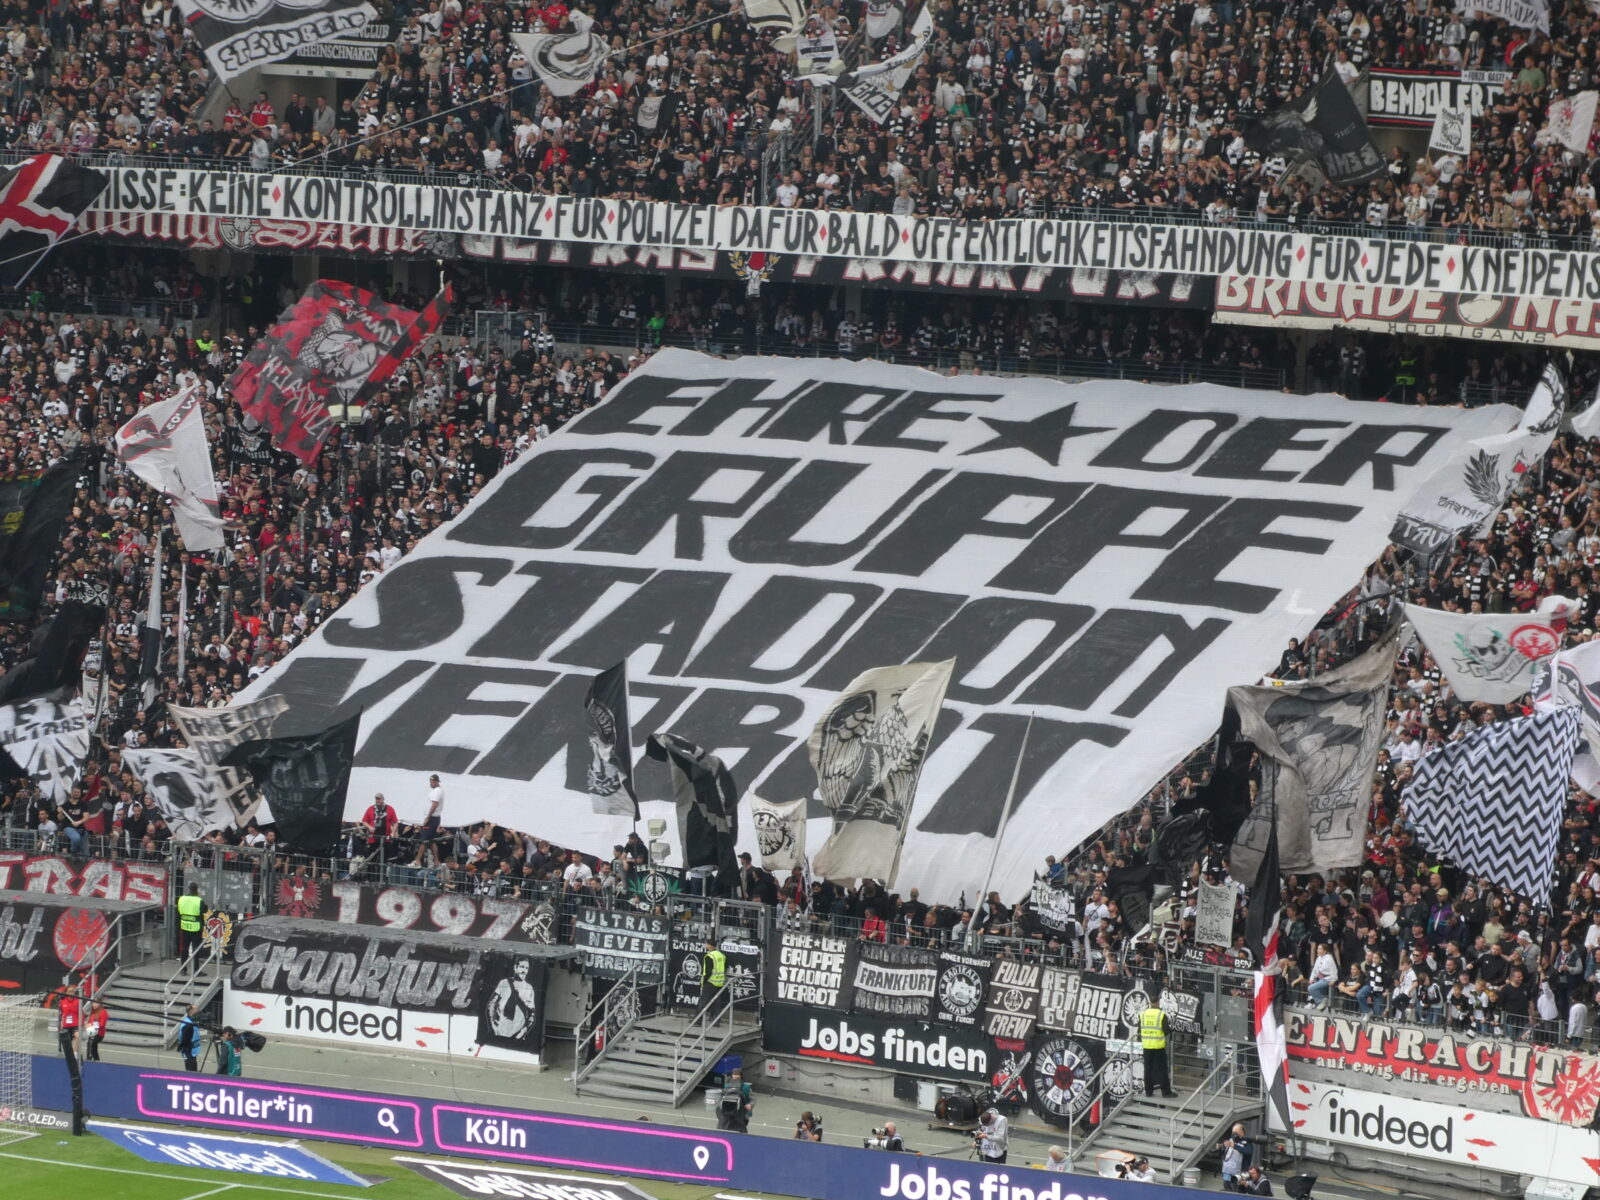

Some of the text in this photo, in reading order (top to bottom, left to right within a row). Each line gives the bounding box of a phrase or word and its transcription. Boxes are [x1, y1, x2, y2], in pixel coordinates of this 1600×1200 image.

[189, 172, 274, 217] KEINE
[283, 176, 547, 237] KONTROLLINSTANZ
[554, 196, 608, 241] FÜR
[616, 199, 722, 250] POLIZEI,
[729, 206, 819, 254] DAFÜR
[826, 212, 900, 257] BALD
[1307, 236, 1362, 283] FÜR
[1366, 239, 1444, 288] JEDE
[566, 374, 1453, 491] EHRE DER
[445, 447, 1364, 614] GRUPPE
[321, 555, 1233, 718] STADION
[332, 882, 531, 940] 1997
[585, 909, 662, 933] ULTRAS
[588, 931, 654, 953] NEVER
[782, 933, 847, 953] EHRE DER
[231, 924, 481, 1009] Frankfurt
[574, 953, 661, 975] SURRENDER
[780, 946, 845, 973] GRUPPE
[777, 966, 842, 989] STADION
[860, 967, 936, 992] FRANKFURT
[994, 960, 1040, 988] FULDA
[1040, 969, 1081, 993] REG
[777, 981, 839, 1007] VERBOT
[993, 991, 1033, 1010] 3 6
[1075, 986, 1123, 1022] RIED
[284, 996, 402, 1042] indeed
[988, 1014, 1032, 1040] CREW
[1043, 1007, 1068, 1028] 64
[1073, 1014, 1119, 1040] GEBIET
[801, 1018, 988, 1075] Jobs finden
[1068, 1041, 1078, 1053] IN
[1282, 1010, 1565, 1088] EINTRACHT
[1316, 1056, 1513, 1095] auf ewig dir ergeben
[28, 1113, 56, 1126] OLED
[465, 1116, 527, 1148] Köln
[1328, 1097, 1454, 1154] indeed
[157, 1141, 318, 1180] indeed
[879, 1163, 972, 1200] Jobs
